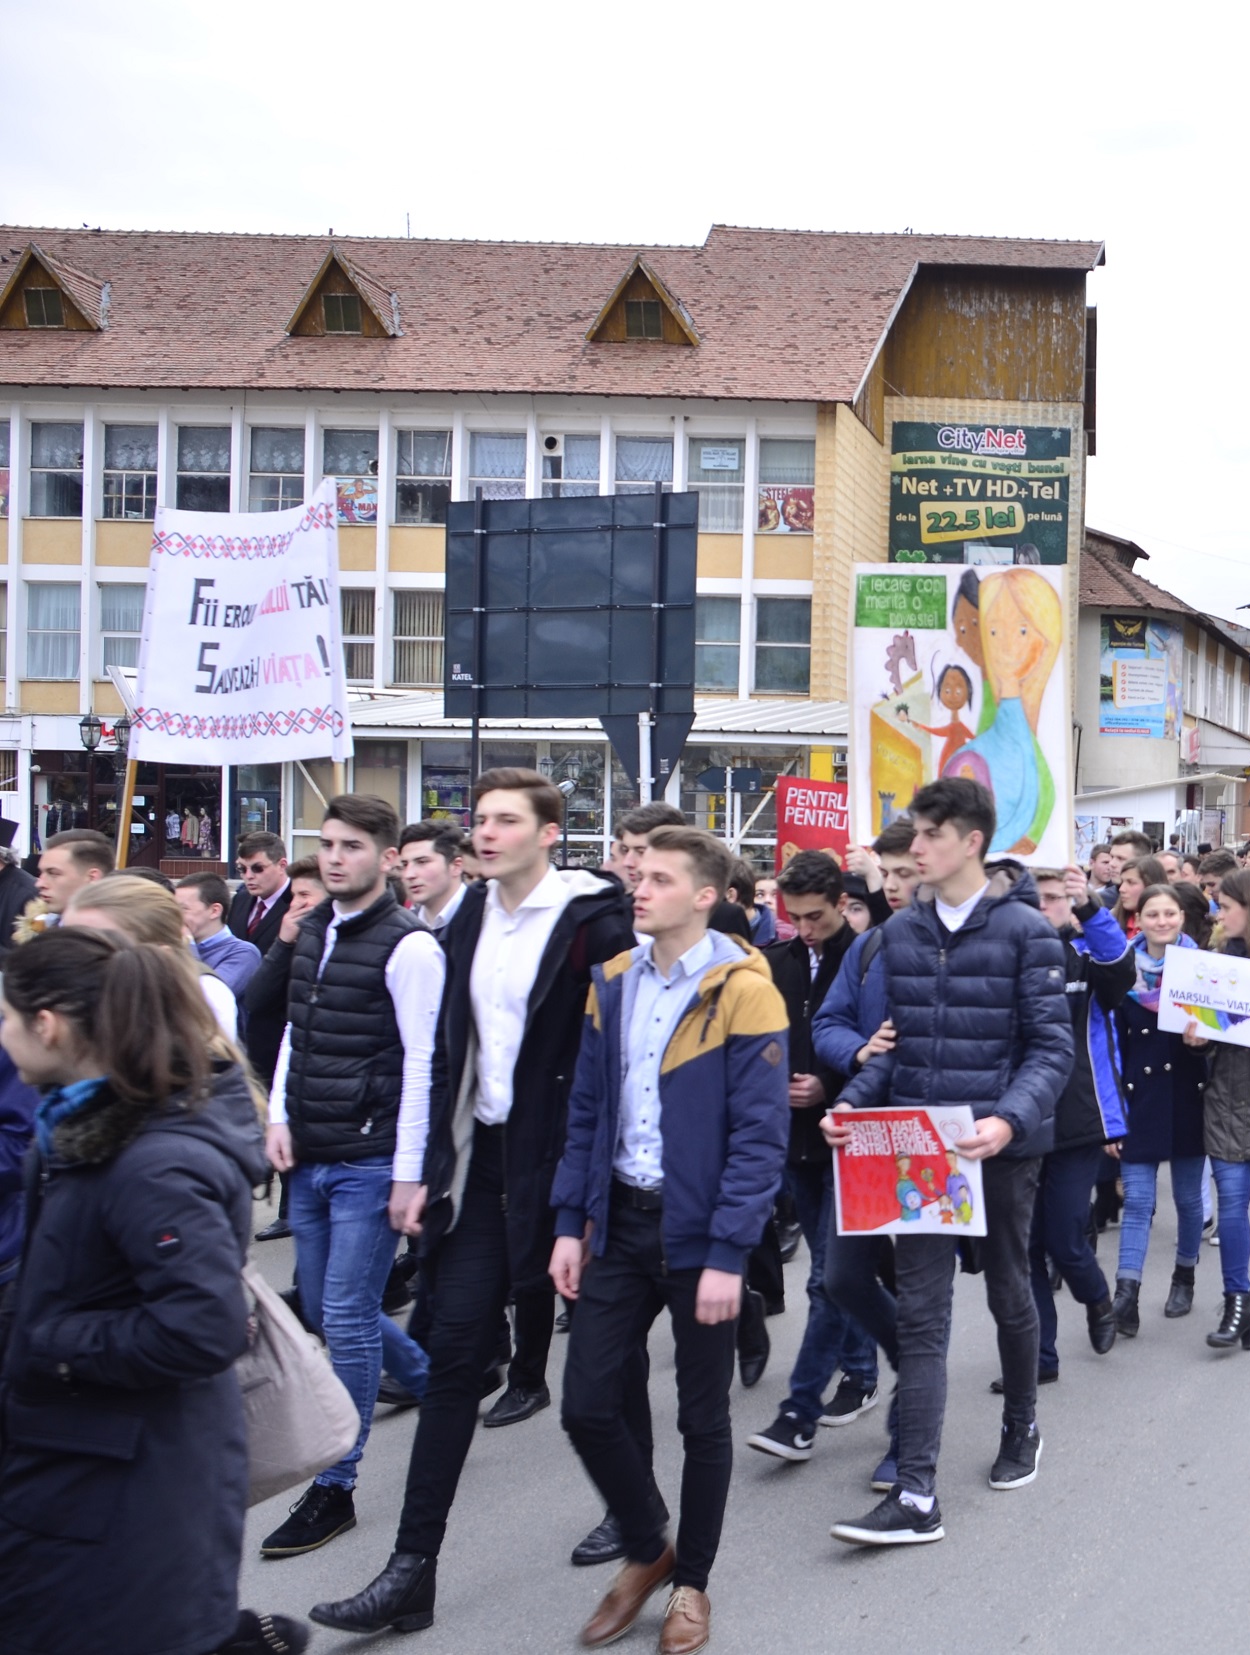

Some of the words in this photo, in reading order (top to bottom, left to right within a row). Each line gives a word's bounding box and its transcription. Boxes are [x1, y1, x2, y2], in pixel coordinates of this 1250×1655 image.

[938, 428, 1026, 452] CityNet
[940, 453, 967, 467] vine
[972, 459, 987, 468] cu
[902, 476, 938, 496] Net
[896, 513, 907, 522] de
[908, 513, 917, 522] la
[926, 509, 980, 534] 22.5
[985, 505, 1016, 530] lei
[1027, 513, 1040, 523] pe
[912, 595, 922, 611] o
[451, 673, 474, 681] KATEL
[844, 1142, 892, 1156] PENTRU
